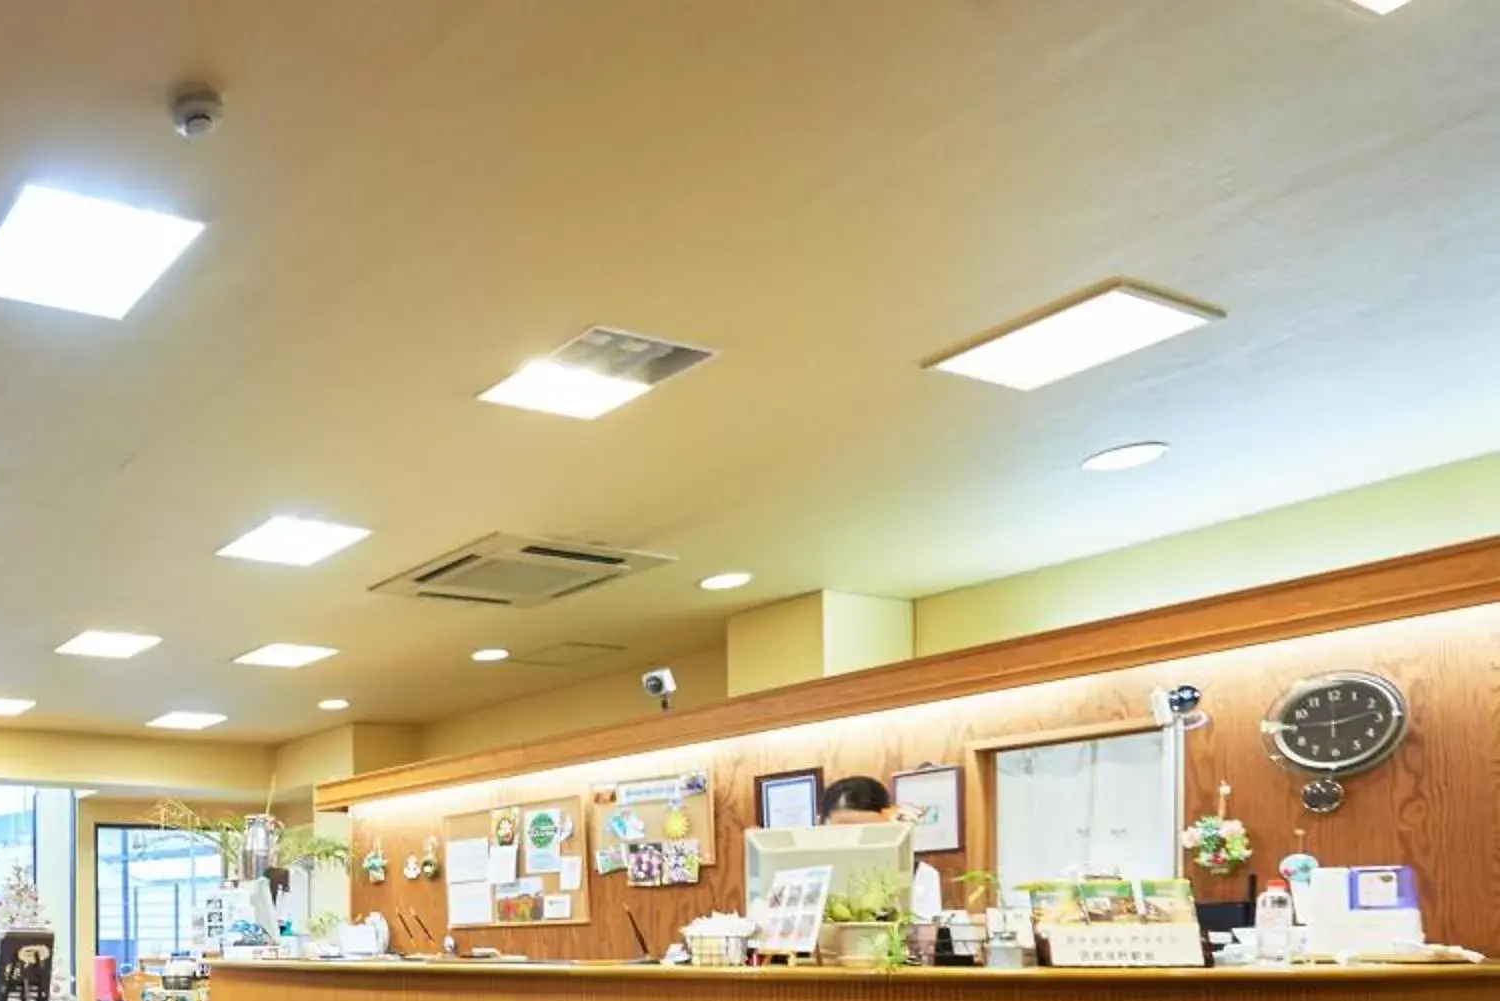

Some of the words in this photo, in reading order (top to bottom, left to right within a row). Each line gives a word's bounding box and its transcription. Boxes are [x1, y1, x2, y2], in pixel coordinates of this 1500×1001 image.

[1327, 689, 1341, 701] 12
[1351, 691, 1358, 702] 1
[1308, 697, 1321, 708] 11
[1367, 698, 1376, 709] 2
[1295, 708, 1309, 720] 10
[1374, 713, 1384, 723] 3
[1365, 727, 1375, 738] 4
[1312, 744, 1320, 756] 7
[1353, 739, 1362, 751] 5
